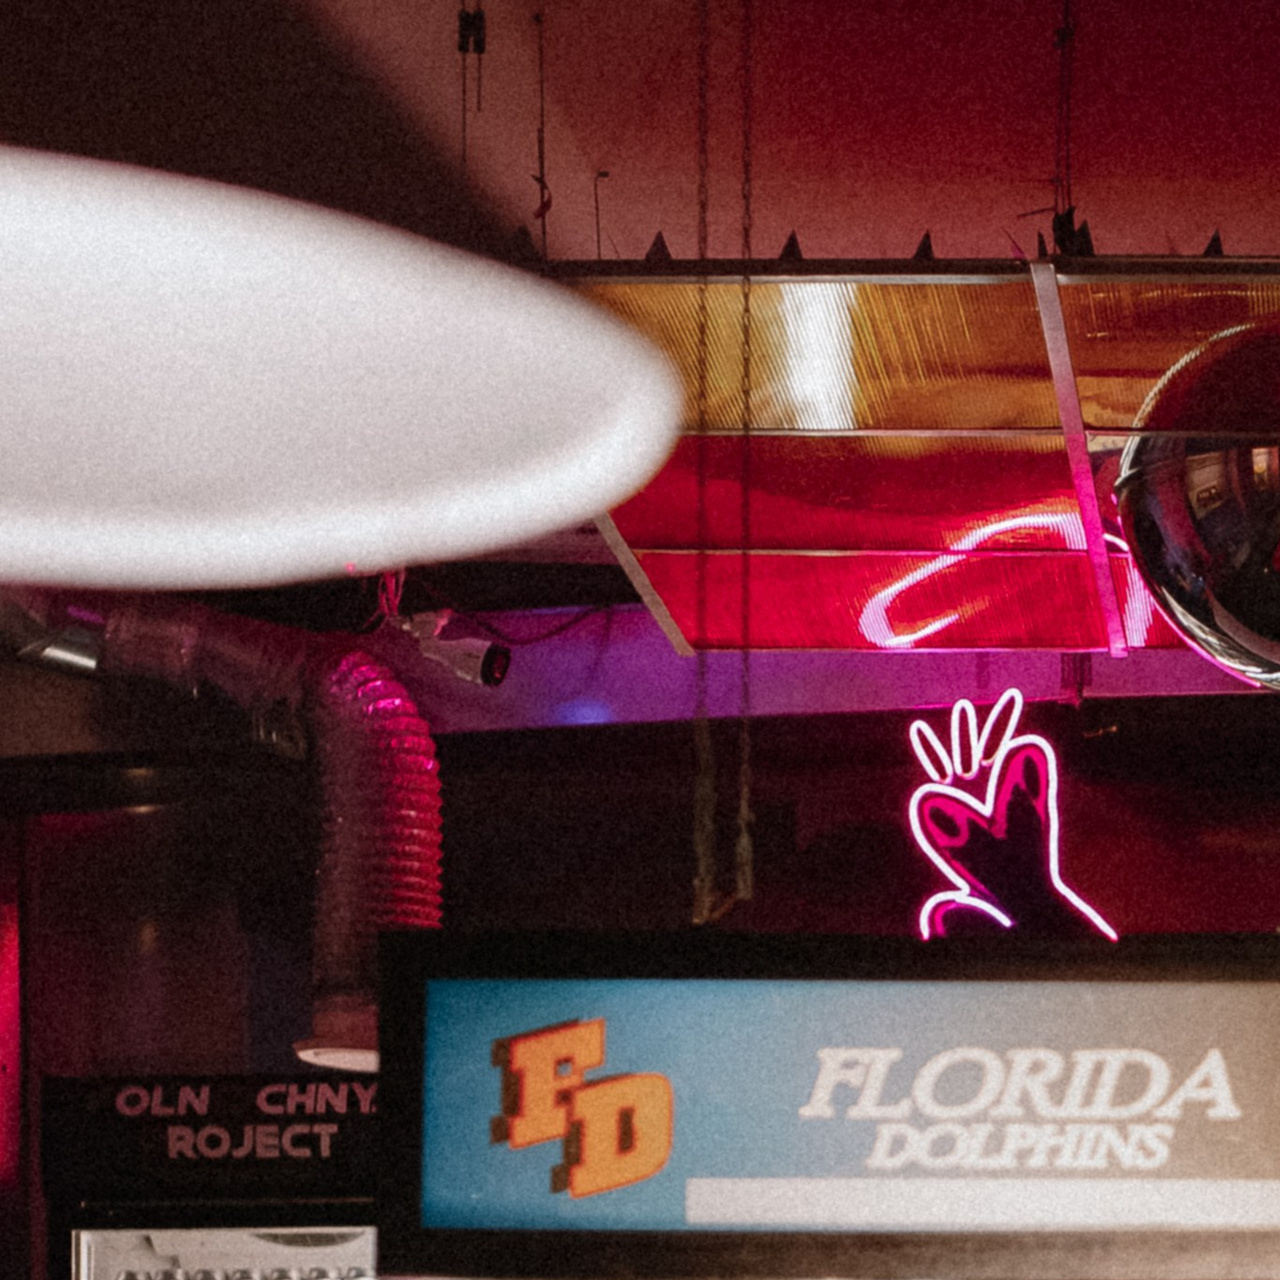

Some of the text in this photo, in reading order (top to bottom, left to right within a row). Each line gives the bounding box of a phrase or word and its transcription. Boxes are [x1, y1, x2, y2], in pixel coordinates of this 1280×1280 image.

[254, 1081, 379, 1116] CHNY
[800, 1046, 1242, 1121] FLORIDA
[865, 1122, 1174, 1171] DOLPHINS
